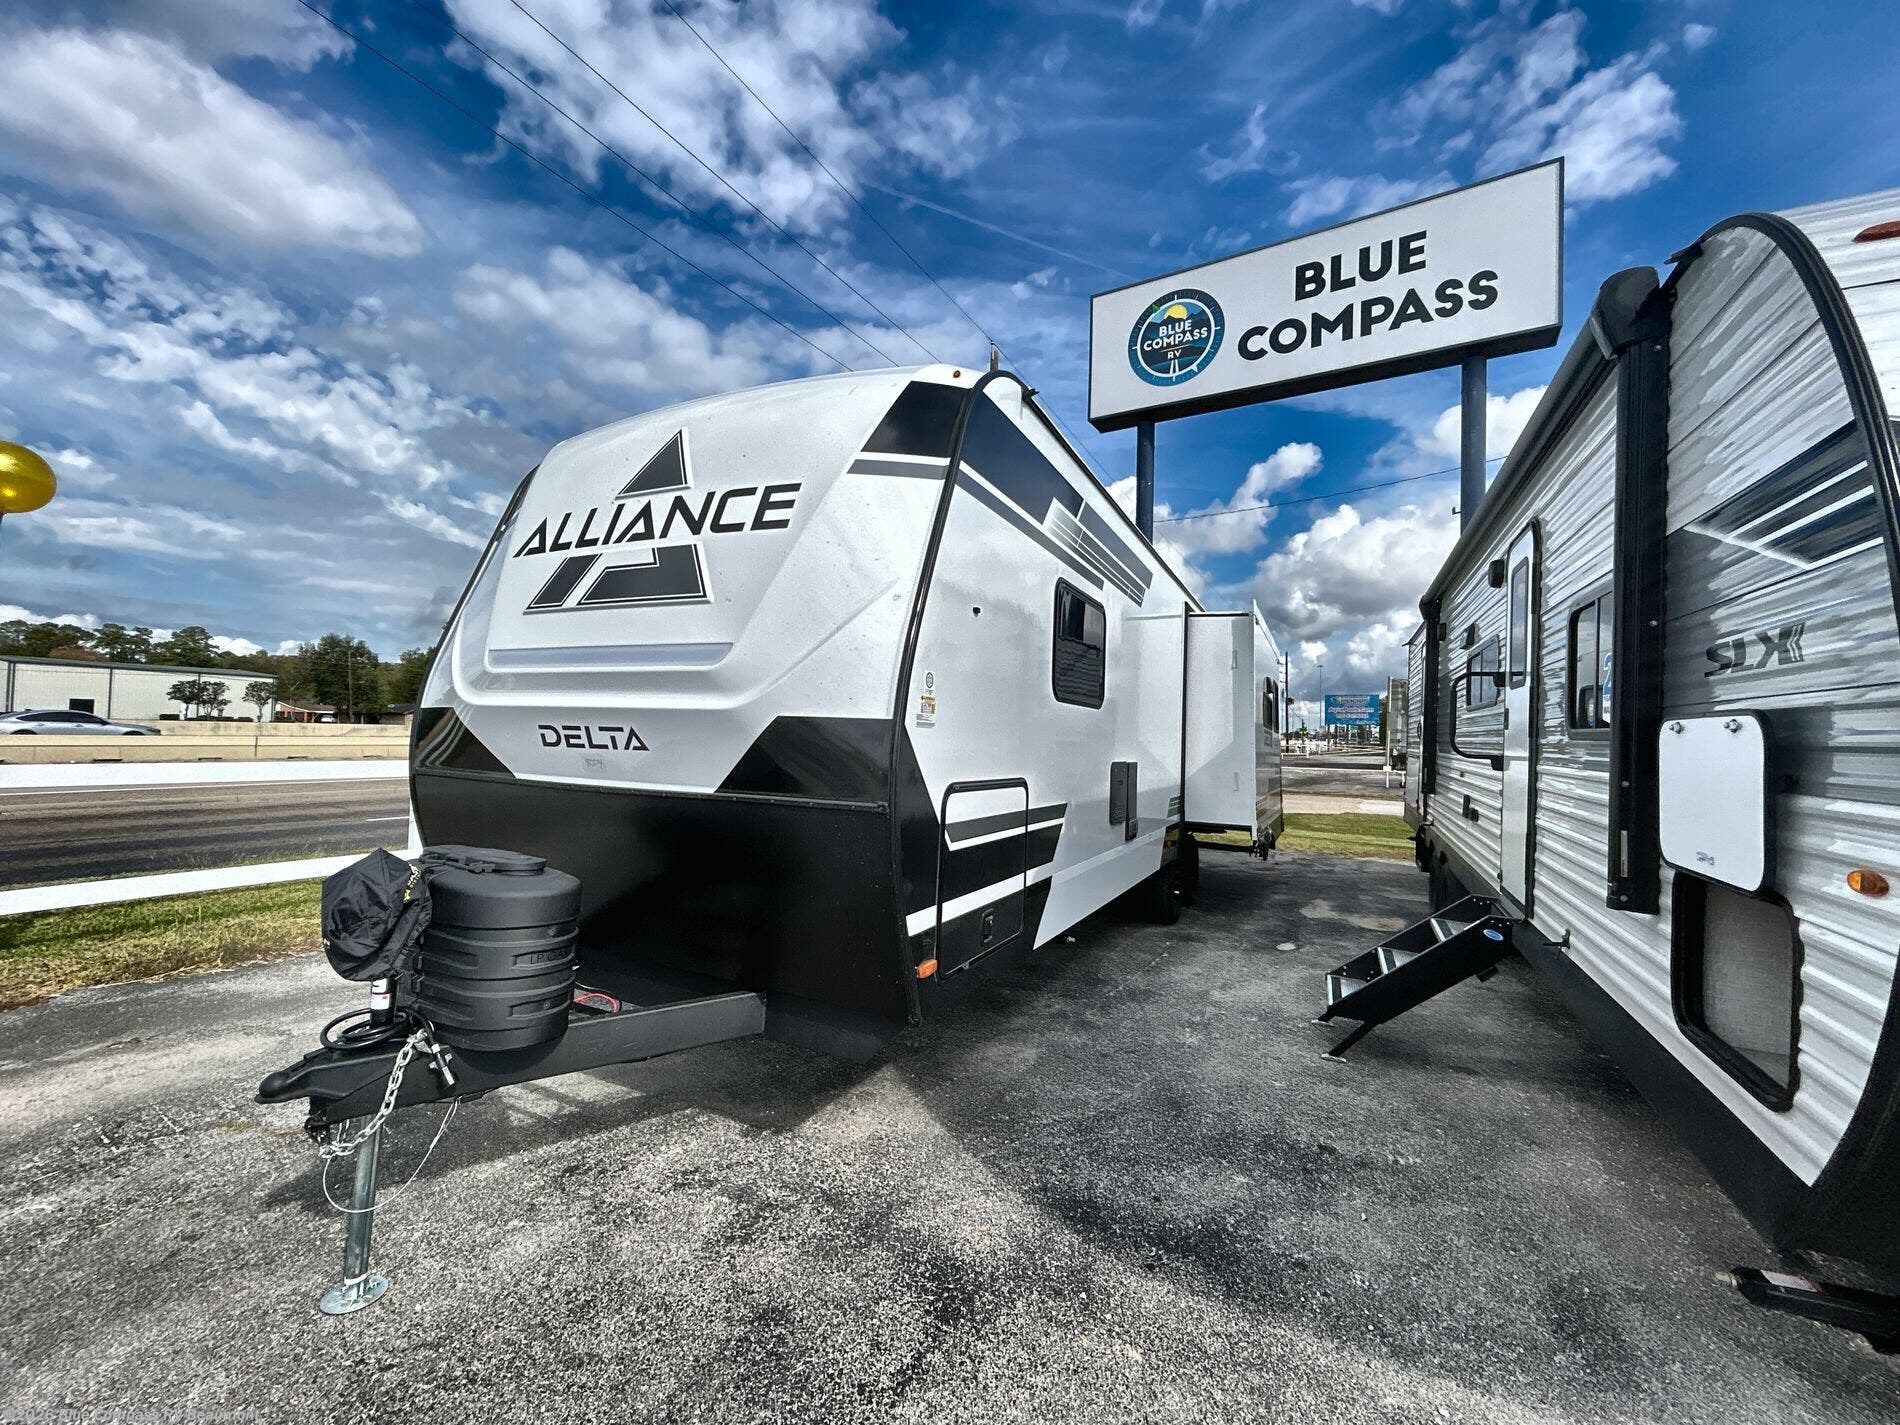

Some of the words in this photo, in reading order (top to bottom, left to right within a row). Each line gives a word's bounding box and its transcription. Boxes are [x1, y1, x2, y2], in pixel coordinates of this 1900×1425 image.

[1295, 230, 1427, 301] BLUE
[1237, 269, 1499, 361] COMPASS
[1143, 327, 1208, 351] COMPASS
[1159, 320, 1192, 337] BLUE
[1167, 349, 1182, 359] RV
[512, 482, 802, 559] ALLIANCE
[537, 724, 650, 752] DELTA
[530, 953, 544, 964] LP
